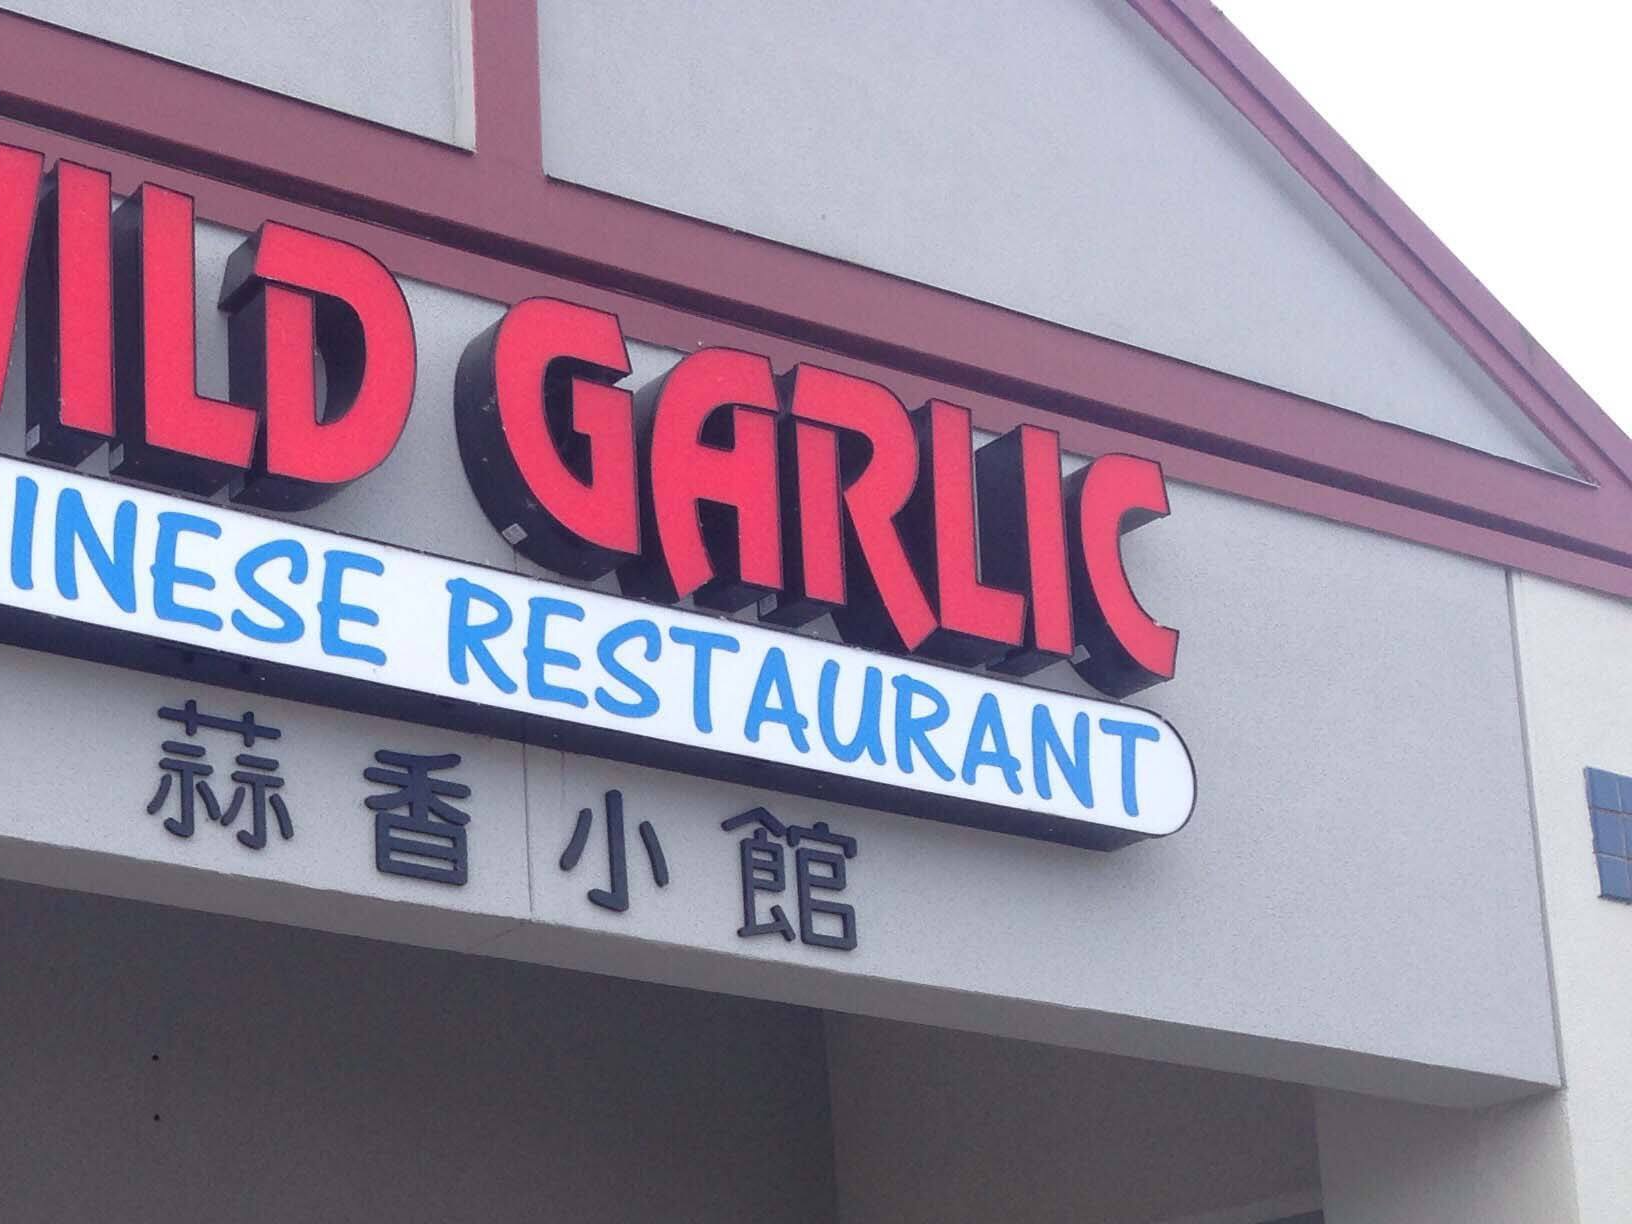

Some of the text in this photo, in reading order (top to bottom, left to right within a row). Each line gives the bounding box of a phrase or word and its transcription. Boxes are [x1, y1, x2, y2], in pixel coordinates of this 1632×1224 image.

[493, 296, 1180, 680] GARLIC
[445, 577, 1161, 818] RESTAURANT
[146, 700, 858, 952] 蒜香小館
